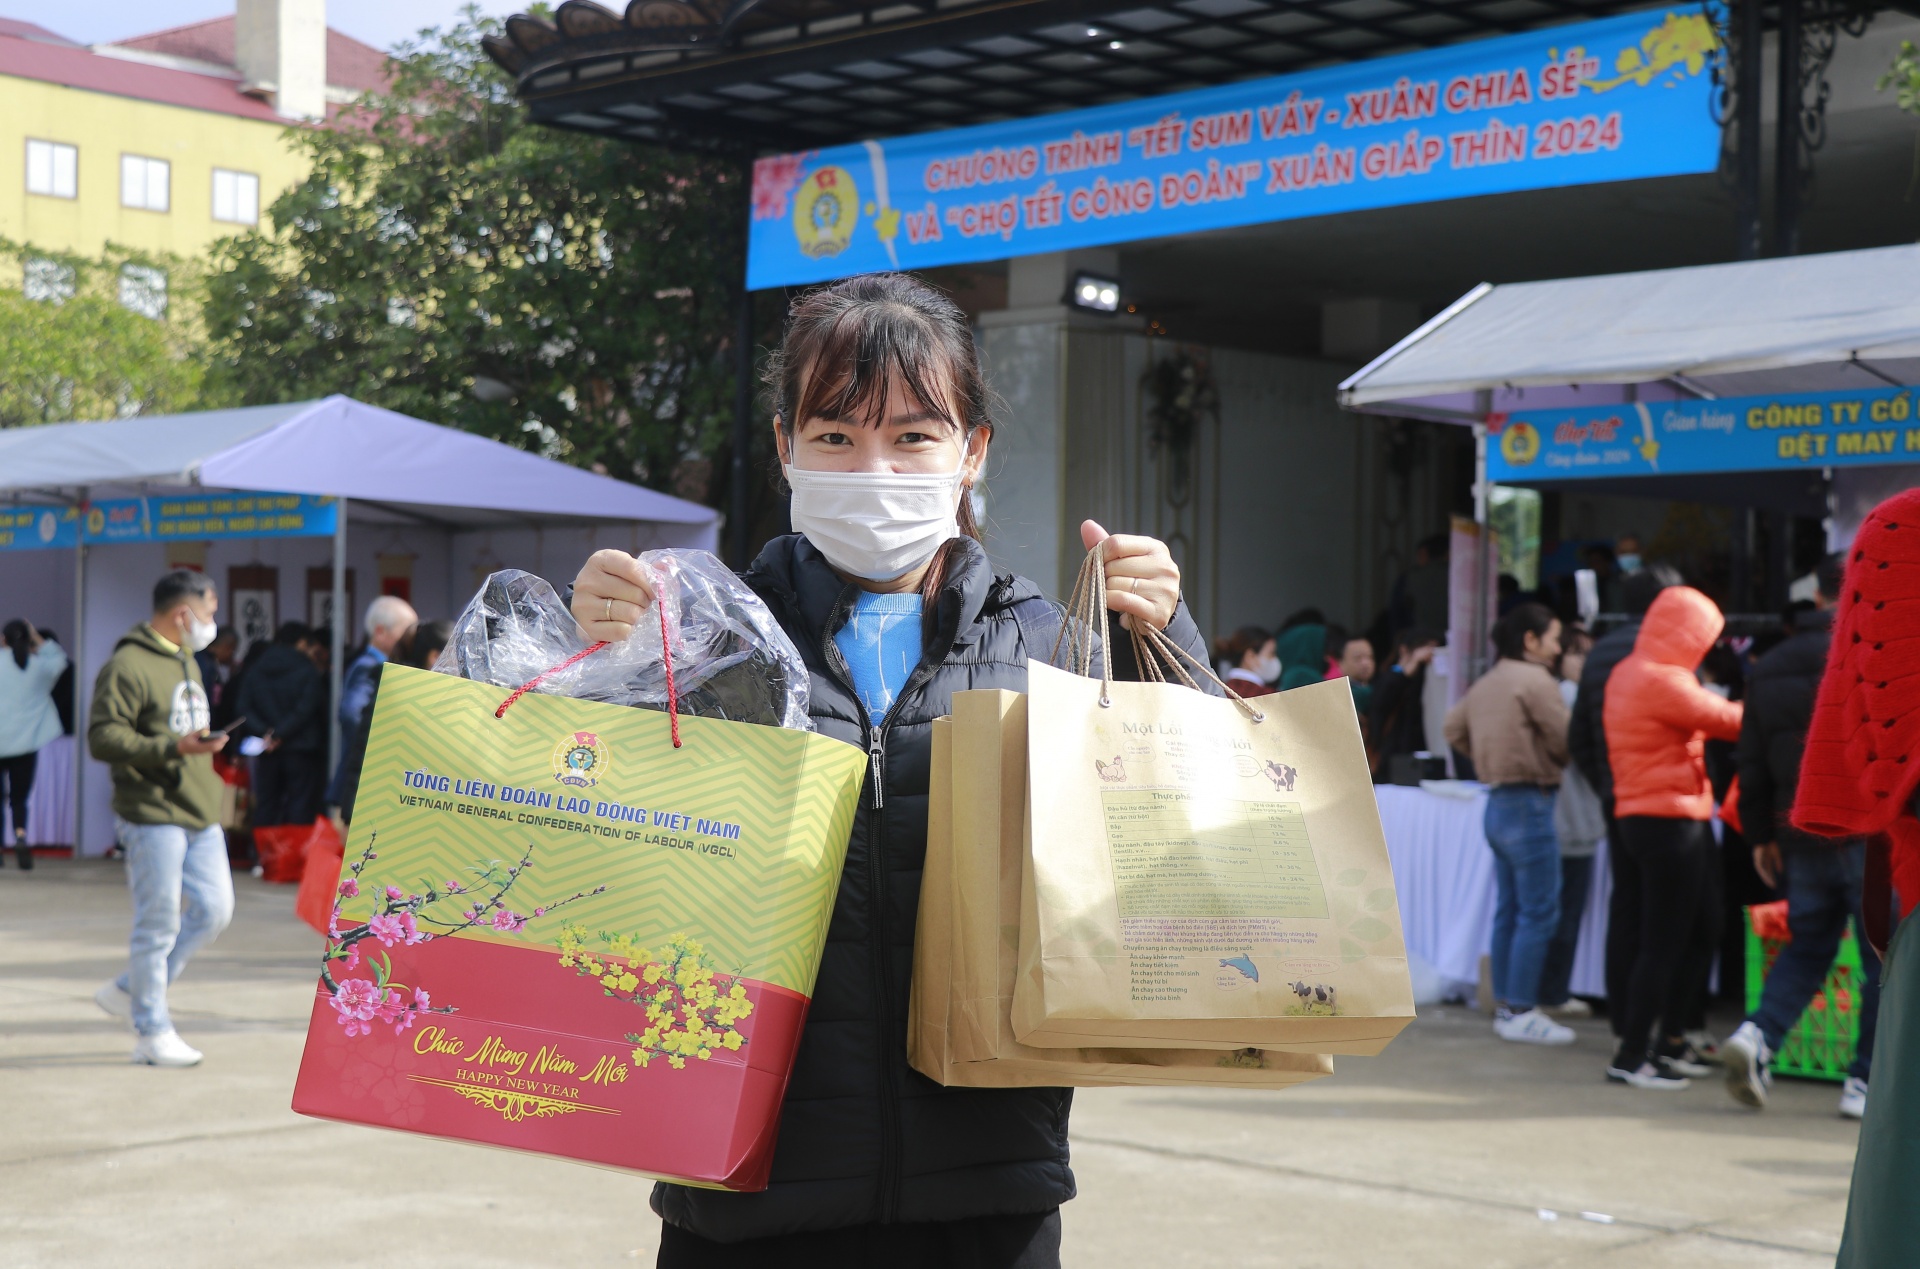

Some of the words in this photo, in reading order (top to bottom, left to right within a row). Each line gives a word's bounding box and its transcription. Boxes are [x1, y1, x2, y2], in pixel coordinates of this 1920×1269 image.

[925, 146, 1038, 191] CHƯƠNG
[1044, 130, 1122, 175] TRÌNH
[1190, 109, 1252, 150] SUM
[1342, 77, 1439, 129] XUÂN
[1445, 67, 1531, 113] CHIA
[905, 202, 942, 244] VÀ
[1024, 181, 1064, 229] TẾT
[1069, 177, 1154, 221] CÔNG
[1265, 142, 1355, 194] XUÂN
[1362, 129, 1443, 178] GIÁP
[1451, 118, 1526, 169] THÌN
[1533, 112, 1621, 159] 2024
[1747, 402, 1822, 429] CÔNG
[1830, 401, 1862, 425] TY
[1778, 430, 1828, 462] DỆT
[1836, 430, 1897, 456] MAY
[1122, 722, 1153, 736] Một
[404, 767, 450, 793] TỔNG
[455, 778, 496, 800] LIÊN
[501, 787, 552, 809] ĐOÀN
[556, 794, 591, 815] LAO
[595, 801, 648, 824] ĐỘNG
[653, 810, 692, 834] VIỆT
[696, 818, 741, 841] NAM
[1151, 793, 1173, 801] Thực
[399, 794, 453, 812] VIETNAM
[456, 803, 514, 822] GENERAL
[517, 813, 622, 839] CONFEDERATION
[624, 830, 642, 842] OF
[644, 835, 695, 851] LABOUR
[697, 842, 737, 861] (VGCL)
[413, 1025, 465, 1056] Chúc
[464, 1035, 530, 1076] Mừng
[529, 1043, 579, 1075] Năm
[579, 1054, 630, 1087] Mới
[456, 1068, 504, 1087] HAPPY
[506, 1077, 540, 1092] NEW
[542, 1083, 580, 1099] YEAR
